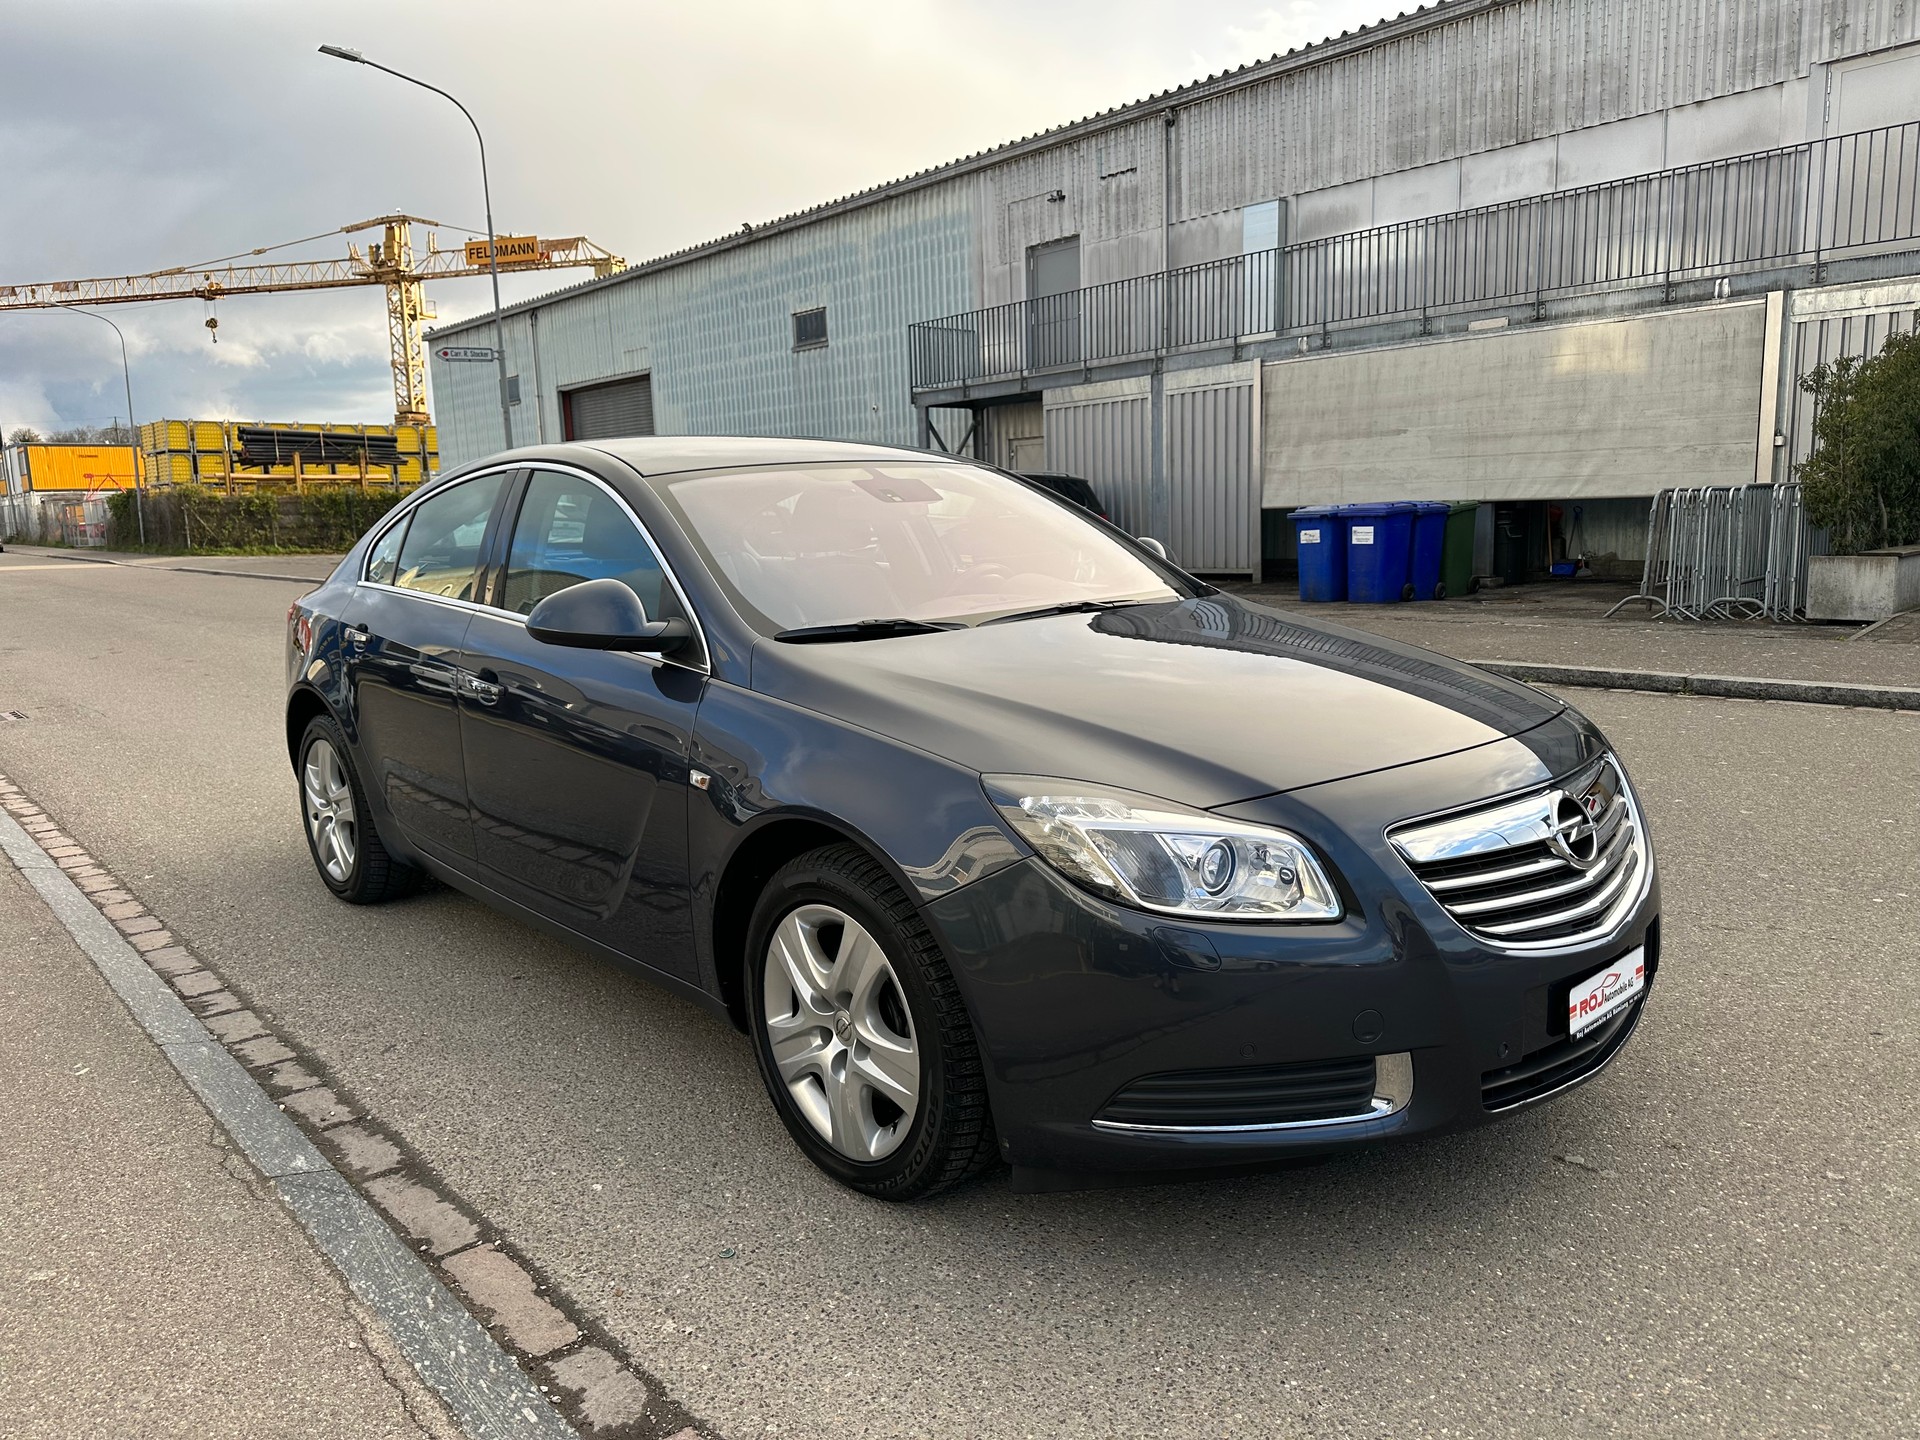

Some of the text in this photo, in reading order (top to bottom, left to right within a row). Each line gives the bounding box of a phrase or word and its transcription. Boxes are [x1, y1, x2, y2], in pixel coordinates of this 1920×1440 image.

[469, 242, 535, 259] FELDMANN
[470, 350, 489, 358] Stocker
[1604, 982, 1627, 1003] Automobile
[1628, 977, 1634, 989] AG
[1584, 1016, 1607, 1034] Automobile
